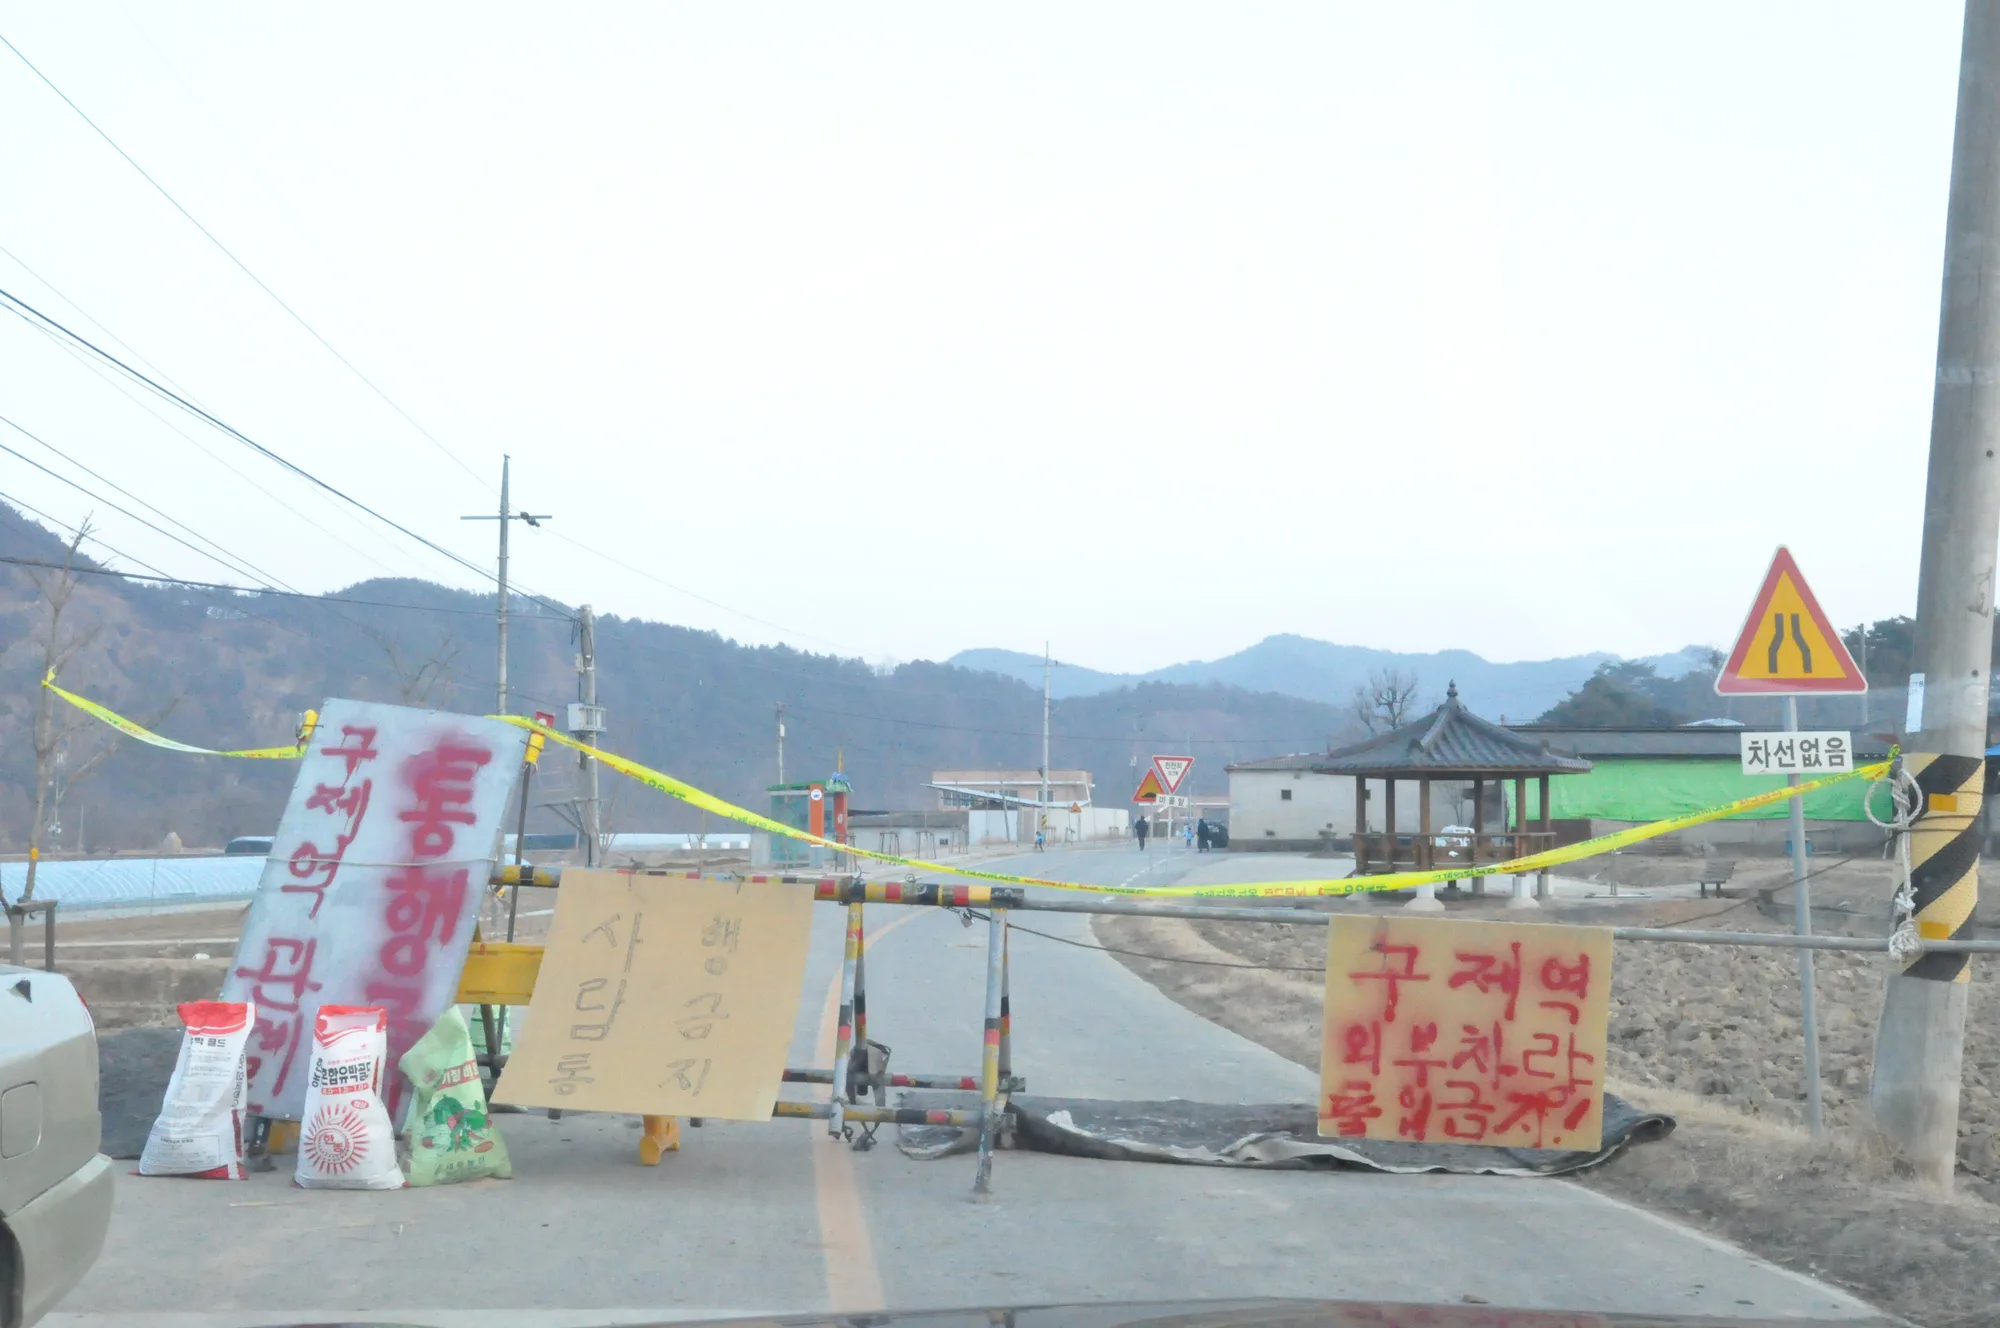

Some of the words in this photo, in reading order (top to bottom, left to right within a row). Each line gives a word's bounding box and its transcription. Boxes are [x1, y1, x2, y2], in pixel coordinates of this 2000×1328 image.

[1747, 736, 1847, 769] 차선없음
[281, 725, 378, 919] 구제역
[1348, 941, 1591, 1025] 구제역
[1341, 1020, 1595, 1108] 외부차량
